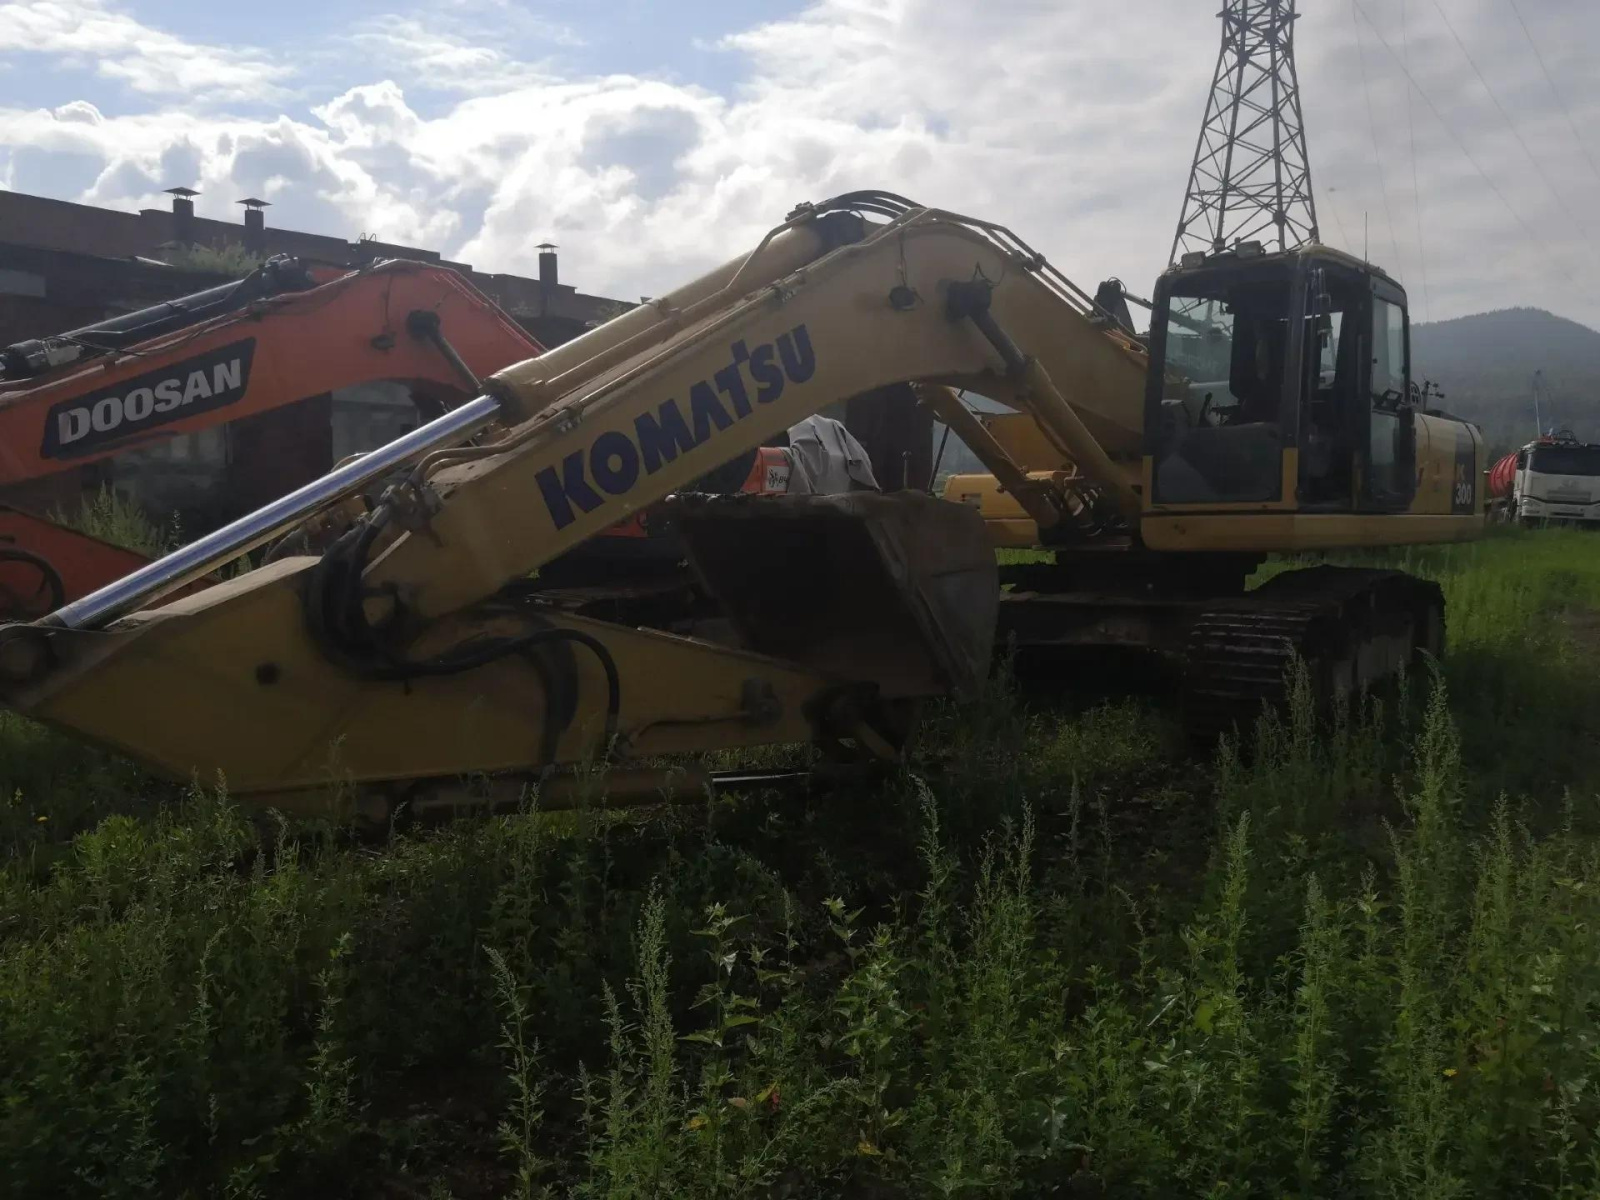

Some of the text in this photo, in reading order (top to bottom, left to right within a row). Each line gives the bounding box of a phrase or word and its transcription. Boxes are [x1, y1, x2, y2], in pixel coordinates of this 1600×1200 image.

[58, 358, 241, 445] DOOSAN
[534, 323, 816, 531] KOMATSU
[1455, 482, 1472, 505] 300
